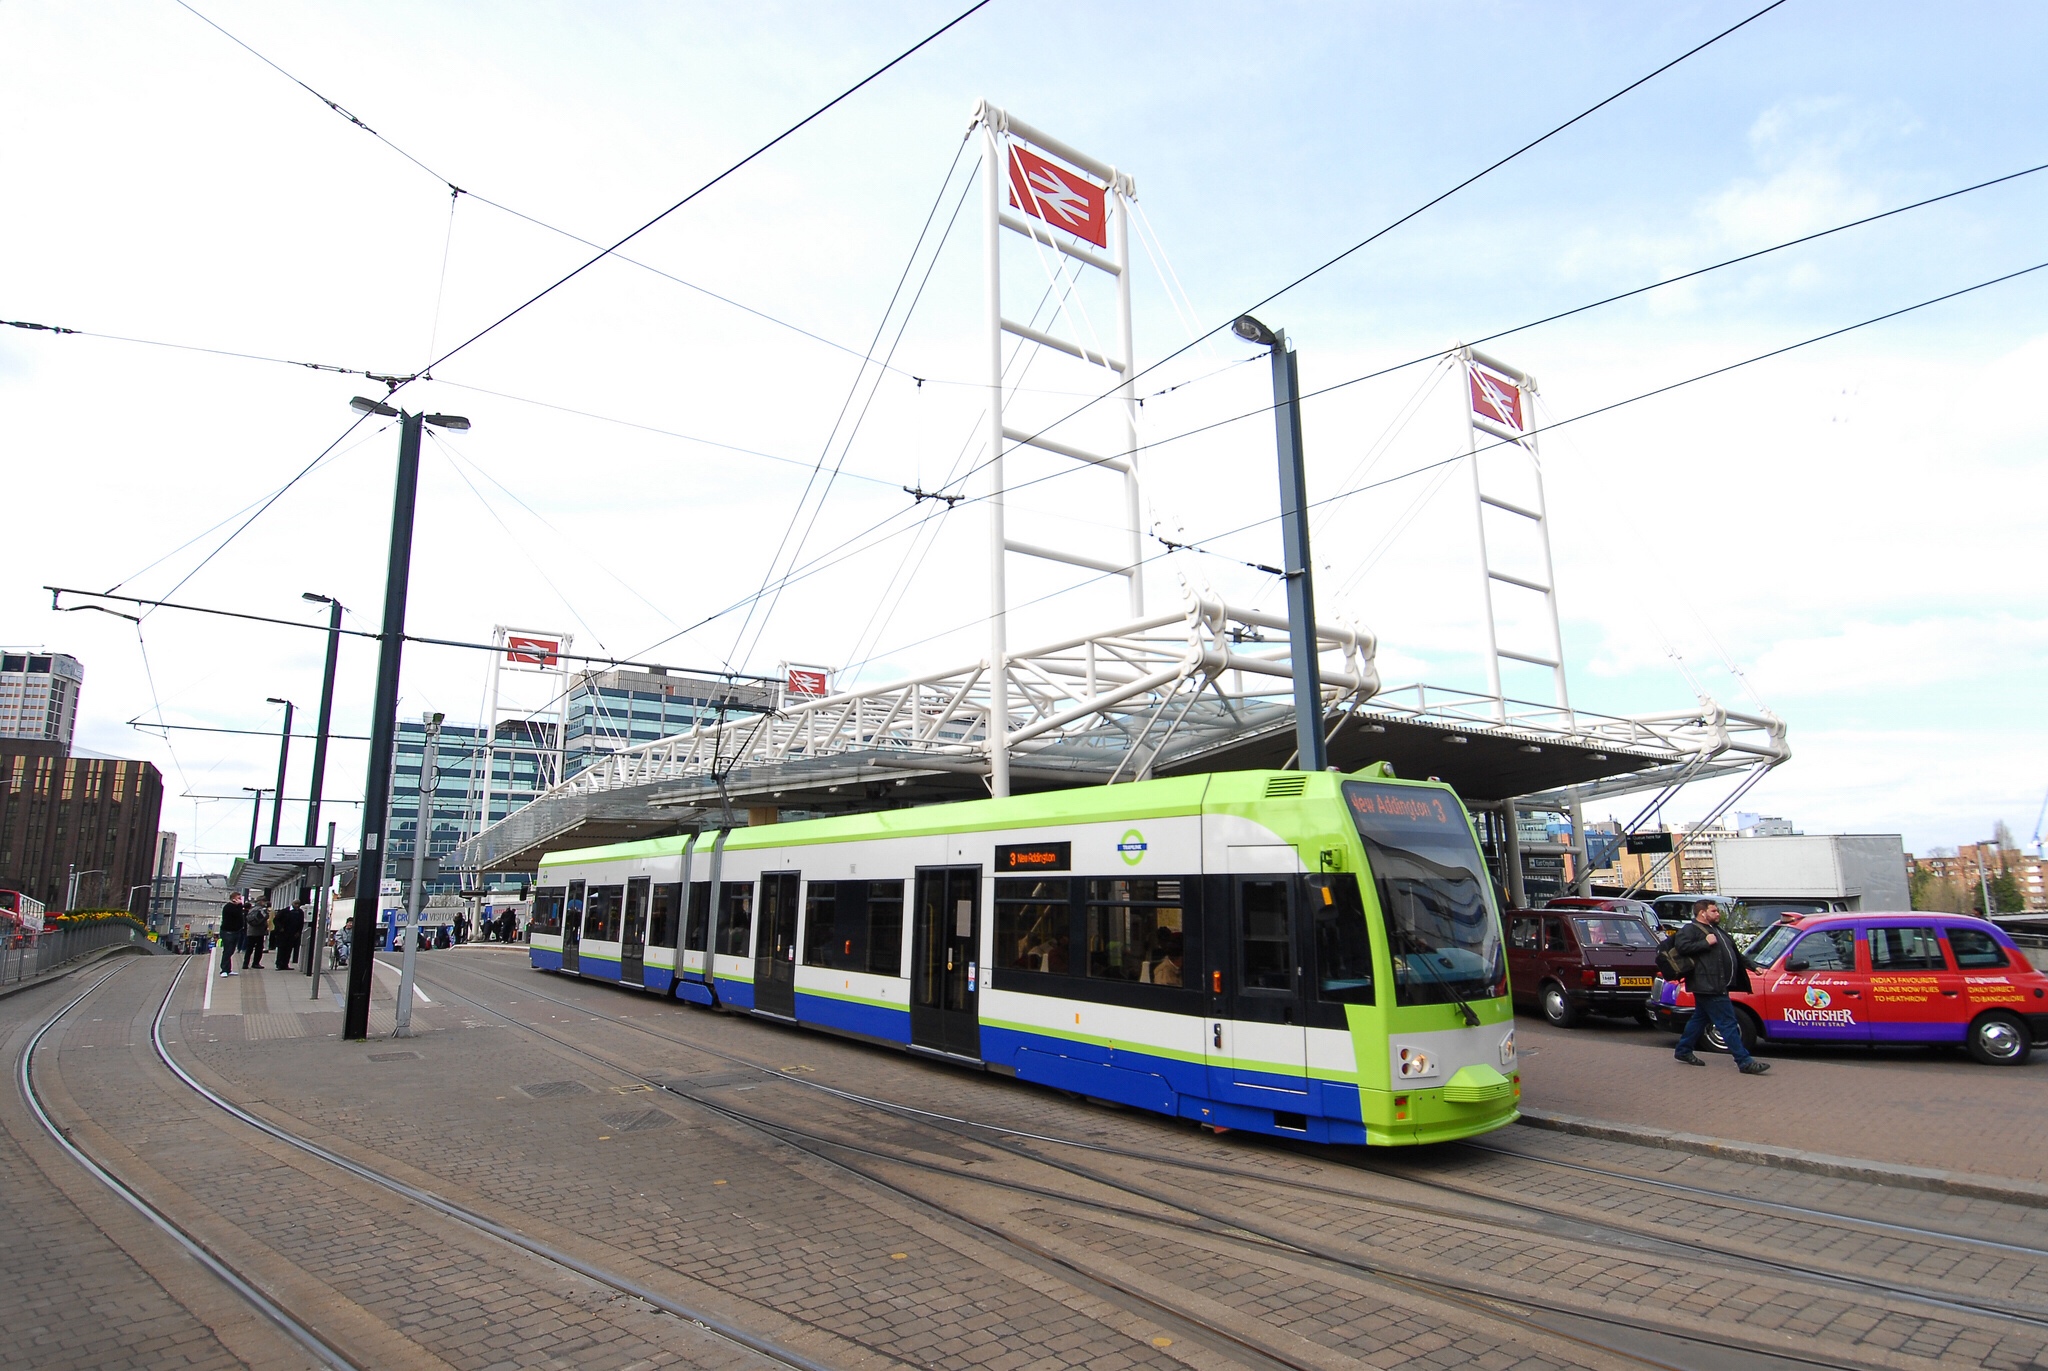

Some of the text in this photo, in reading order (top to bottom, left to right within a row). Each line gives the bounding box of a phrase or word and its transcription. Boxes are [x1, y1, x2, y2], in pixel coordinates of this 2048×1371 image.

[1350, 792, 1447, 823] New Addington 3
[1009, 852, 1056, 866] 3 New Addington
[1771, 973, 1797, 992] feel
[1797, 976, 1806, 985] it
[1808, 973, 1832, 986] best
[1783, 1008, 1856, 1025] KINGFISHER
